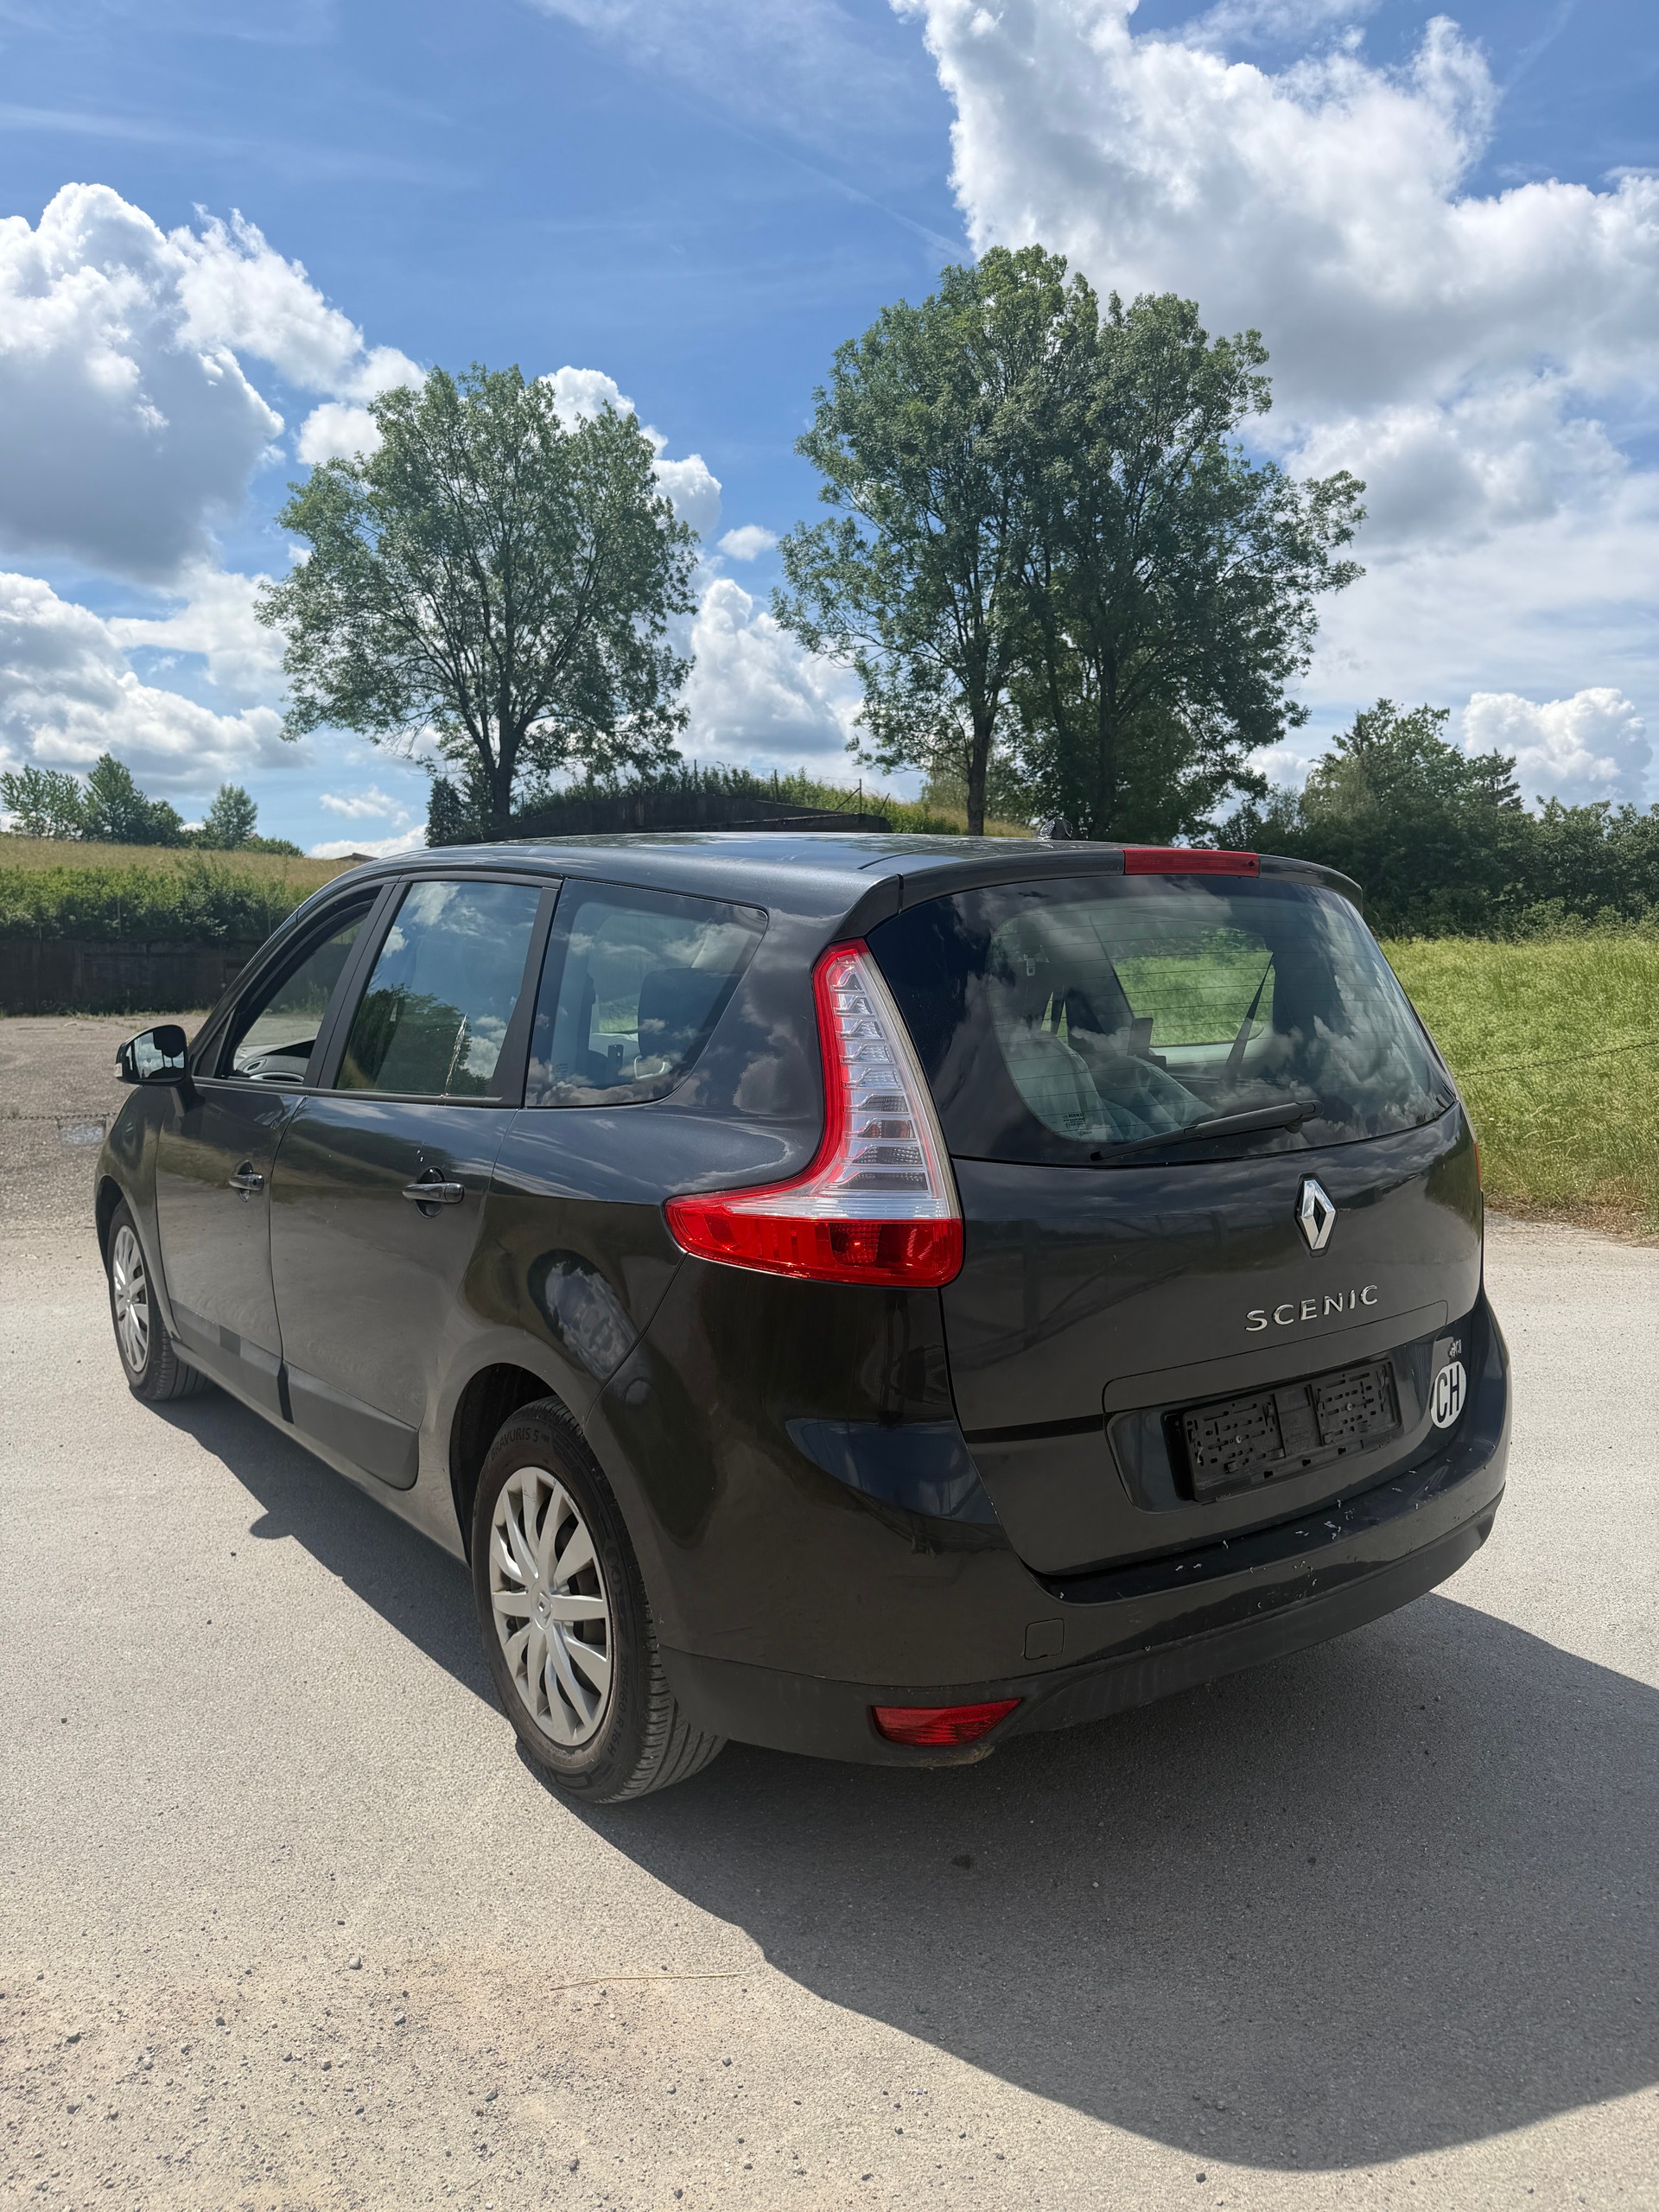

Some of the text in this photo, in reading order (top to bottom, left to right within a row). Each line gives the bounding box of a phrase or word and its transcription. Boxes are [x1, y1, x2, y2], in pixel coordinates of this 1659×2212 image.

[1245, 1284, 1380, 1332] SCENIC
[1437, 1363, 1459, 1423] CH
[532, 1430, 539, 1442] 5
[619, 1652, 628, 1712] 205/60
